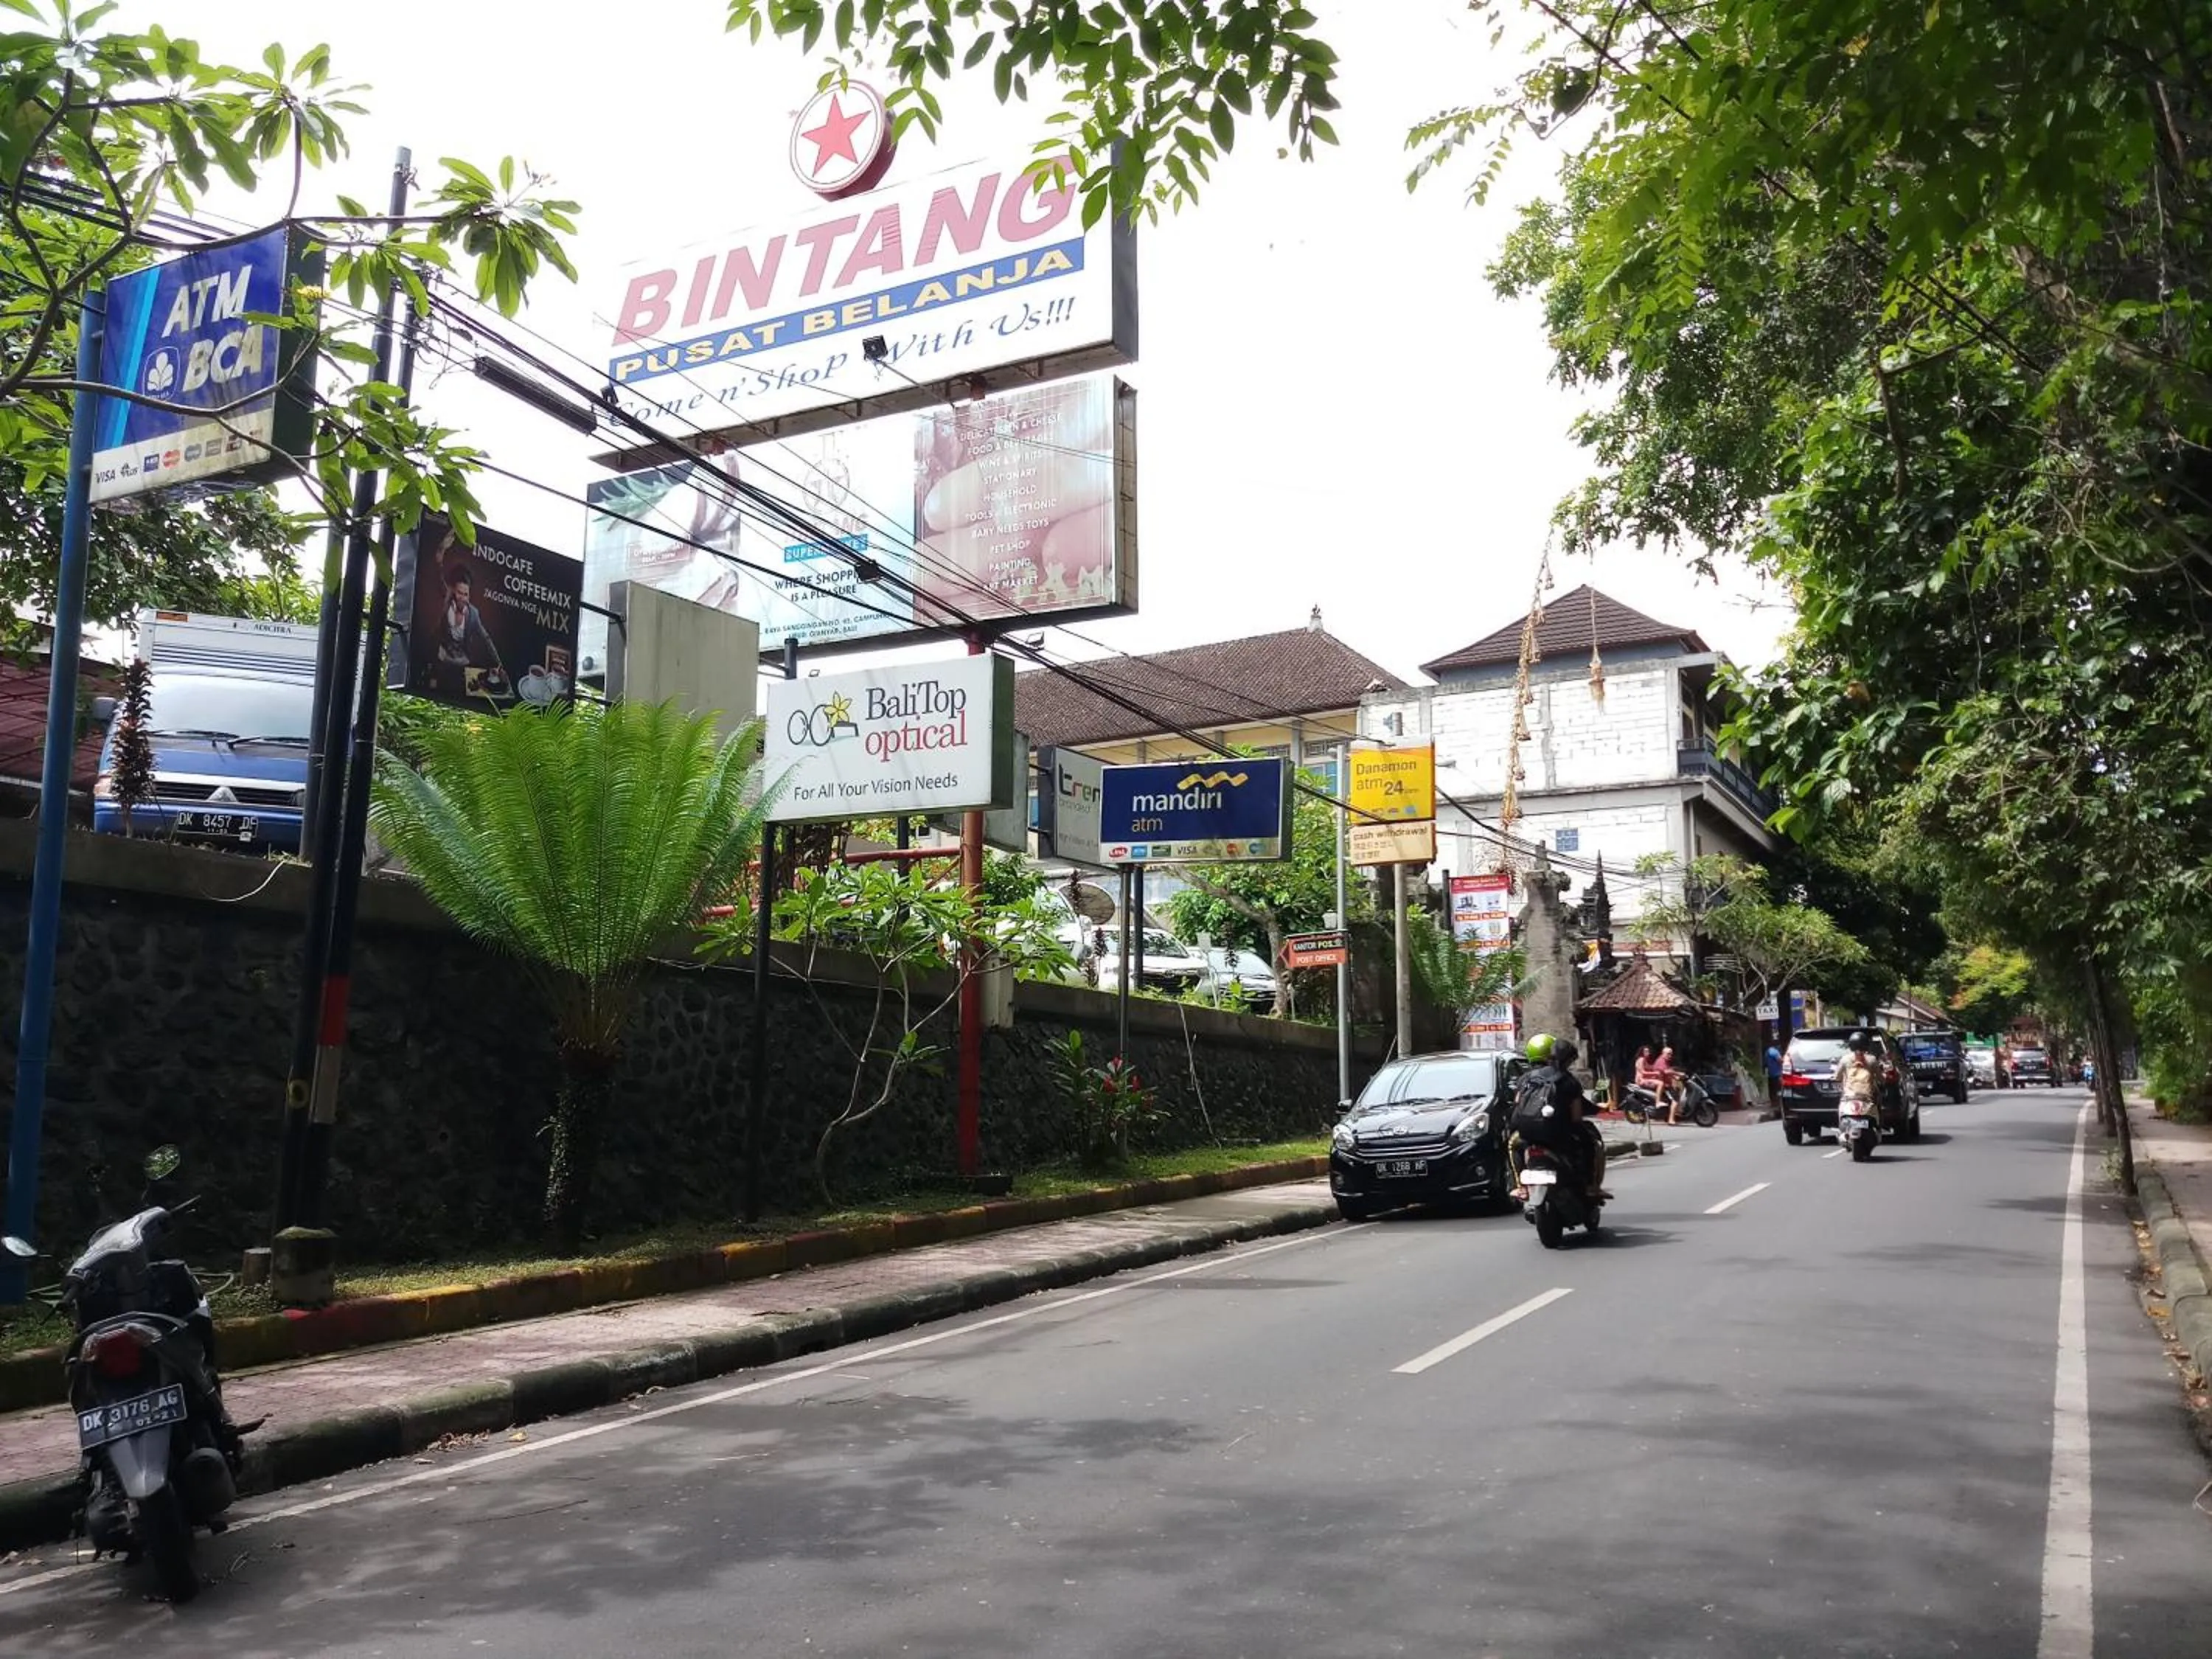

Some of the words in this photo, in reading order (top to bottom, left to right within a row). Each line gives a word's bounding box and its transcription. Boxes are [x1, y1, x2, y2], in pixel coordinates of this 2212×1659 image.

[612, 154, 1077, 347] BINTANG
[162, 265, 252, 337] ATM
[616, 320, 787, 380] PUSAT
[802, 248, 1074, 337] BELANJA
[183, 324, 263, 392] BCA
[968, 443, 992, 456] FOOD
[978, 458, 1001, 470] WINE
[95, 470, 116, 484] VISA
[1026, 518, 1051, 530] TOYS
[472, 543, 534, 576] INDOCAFE
[989, 558, 1032, 571] PAINTING
[1002, 575, 1038, 588] MARKET
[504, 575, 572, 611] COFFEEMIX
[801, 592, 809, 601] A
[865, 709, 968, 762] optical
[1357, 761, 1416, 775] Danamon
[794, 787, 815, 801] For
[818, 782, 835, 799] All
[837, 782, 868, 798] Your
[871, 777, 911, 794] Vision
[915, 772, 959, 790] Needs
[1356, 778, 1383, 790] atm
[1384, 780, 1404, 796] 24
[1132, 787, 1222, 812] mandiri
[178, 812, 193, 826] DK
[203, 813, 232, 828] 8457
[1132, 816, 1163, 832] atm
[1354, 831, 1374, 841] cash
[1178, 846, 1197, 855] VISA
[1297, 956, 1313, 964] POST
[83, 1411, 102, 1431] DK
[111, 1399, 150, 1424] 3176
[158, 1390, 178, 1408] AG
